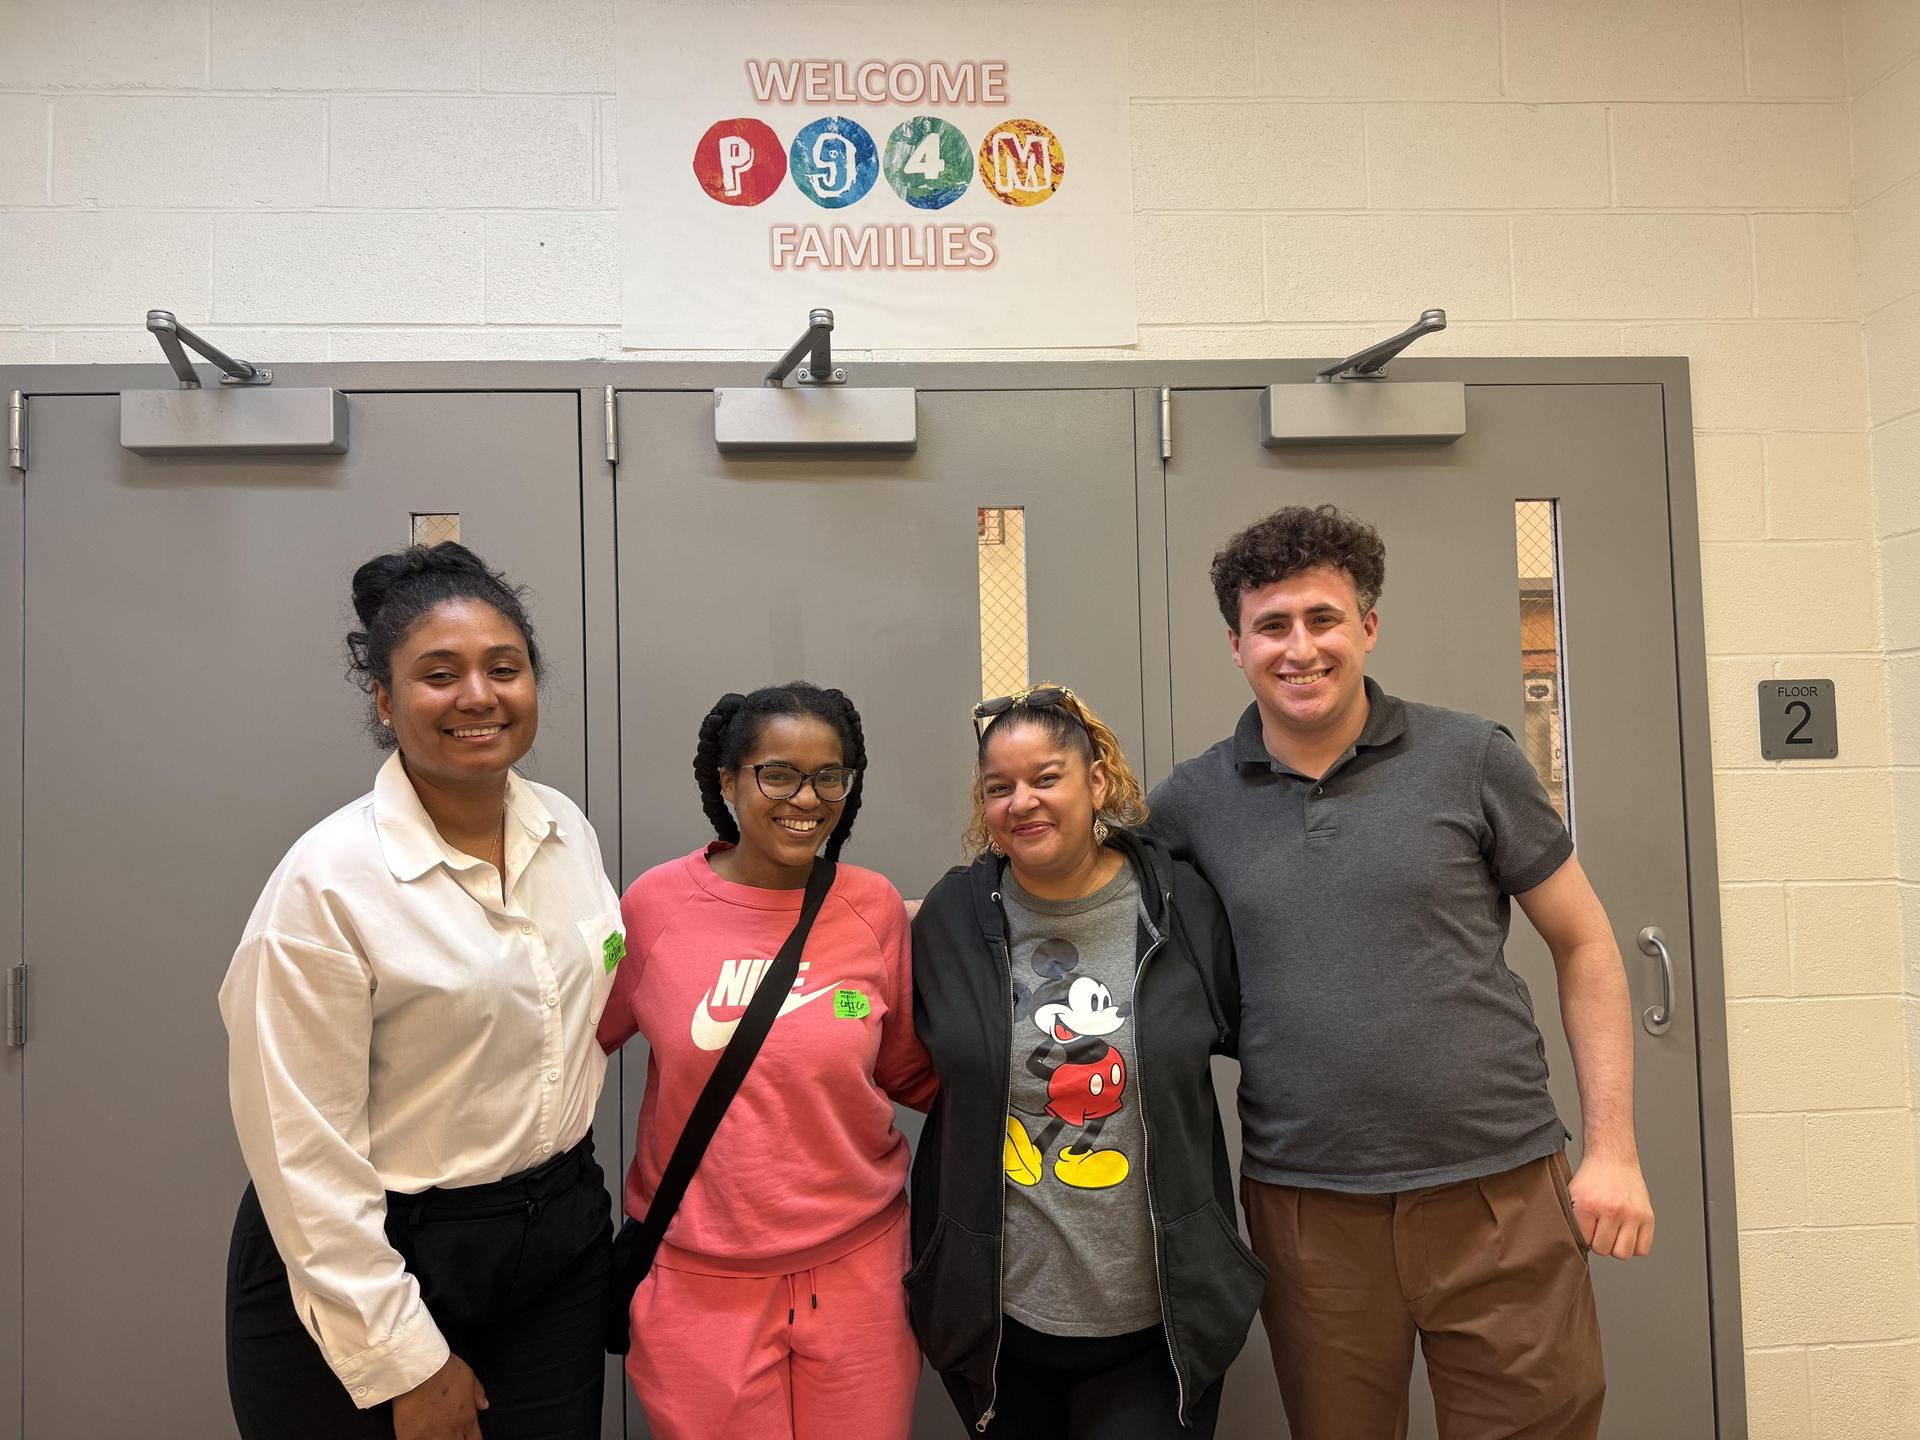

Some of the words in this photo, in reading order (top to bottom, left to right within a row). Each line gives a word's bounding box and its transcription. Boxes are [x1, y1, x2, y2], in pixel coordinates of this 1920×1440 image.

[746, 60, 1008, 104] WELCOME
[770, 225, 997, 269] FAMILIES
[1777, 686, 1818, 697] FLOOR
[1784, 700, 1813, 745] 2
[710, 959, 812, 1007] NIE
